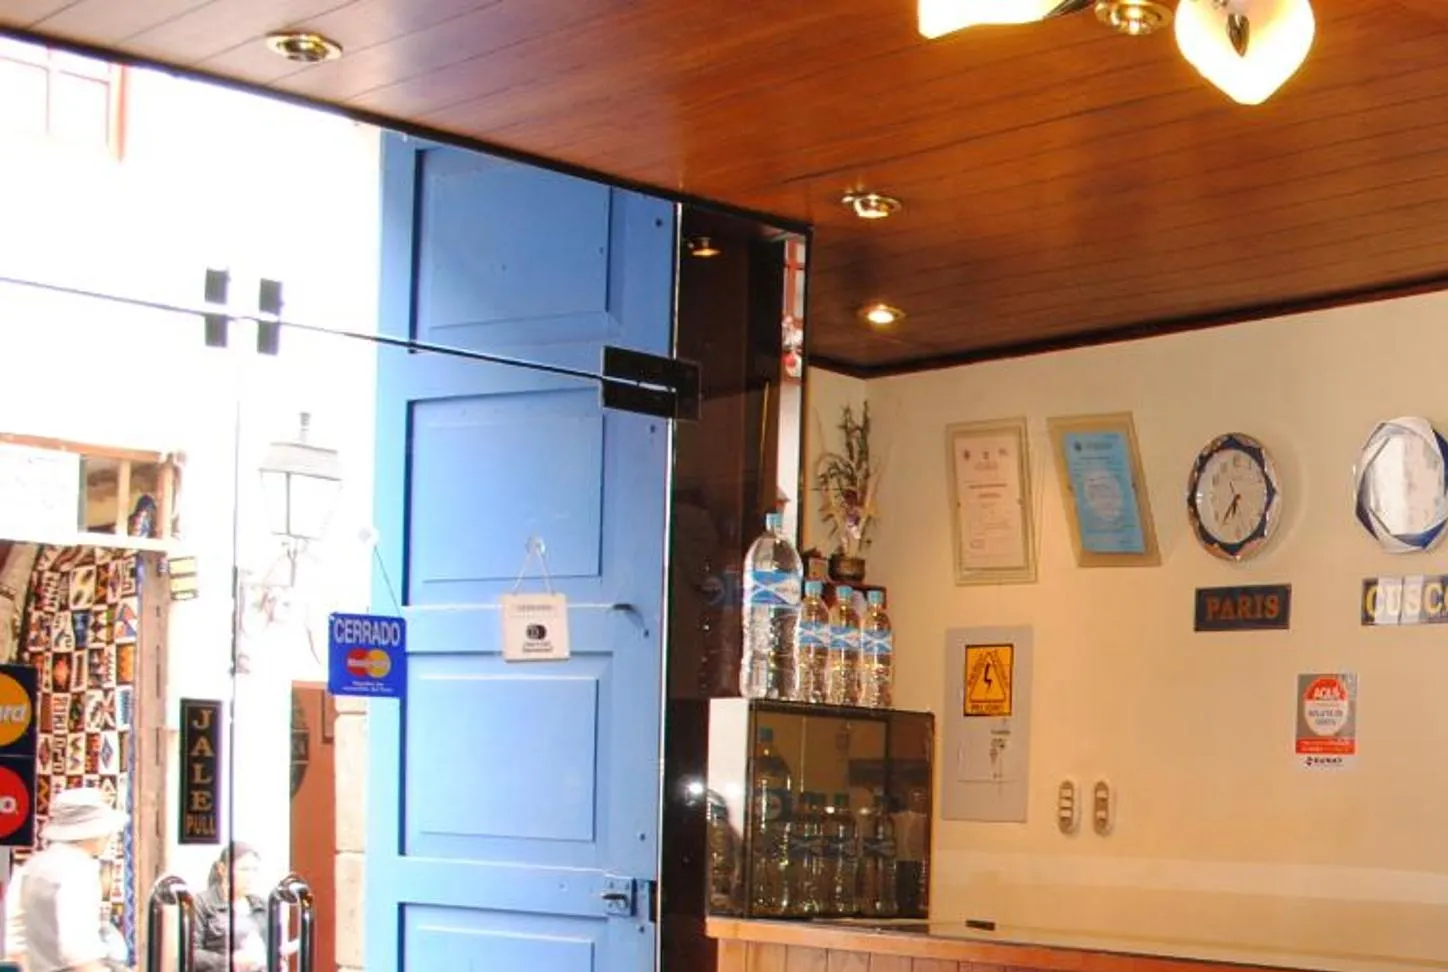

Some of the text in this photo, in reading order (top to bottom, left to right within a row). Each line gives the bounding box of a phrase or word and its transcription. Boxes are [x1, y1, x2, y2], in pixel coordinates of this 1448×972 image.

[1206, 593, 1279, 621] PARIS
[334, 618, 400, 648] CERRADO
[189, 709, 215, 812] JALE
